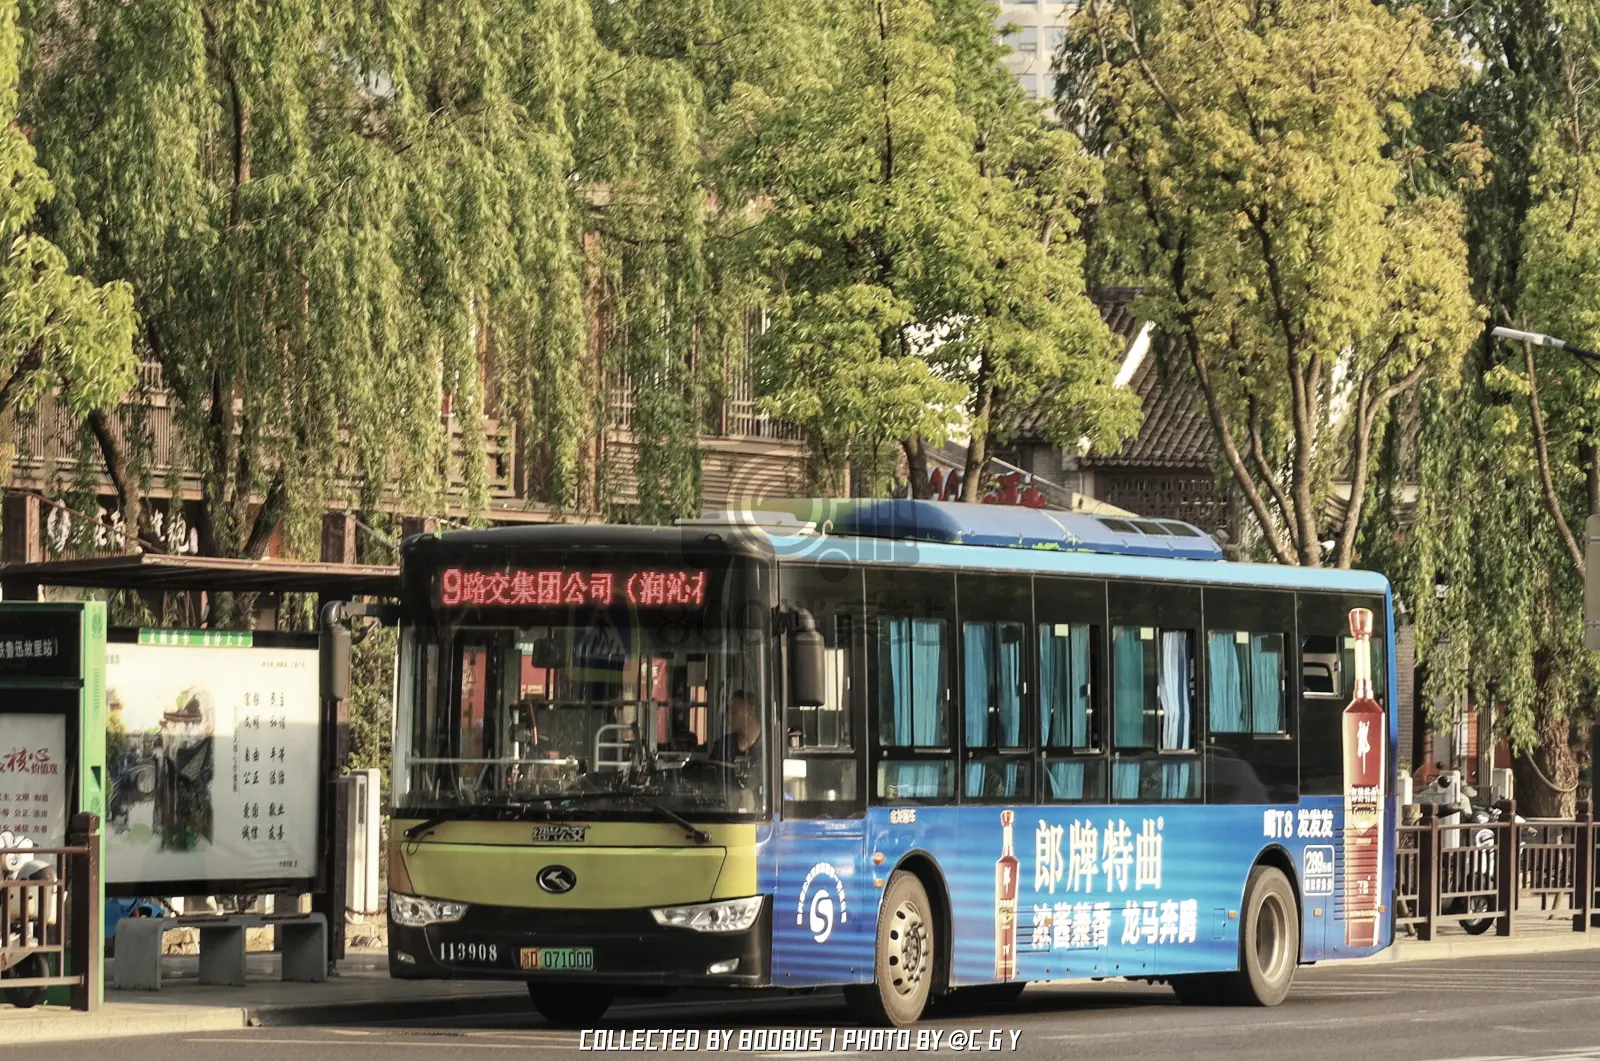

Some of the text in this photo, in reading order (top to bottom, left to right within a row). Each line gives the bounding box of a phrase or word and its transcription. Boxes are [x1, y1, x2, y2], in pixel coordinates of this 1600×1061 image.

[1034, 817, 1164, 895] 郎牌特曲
[1121, 898, 1198, 944] 龙马奔腾
[440, 942, 497, 962] 113908
